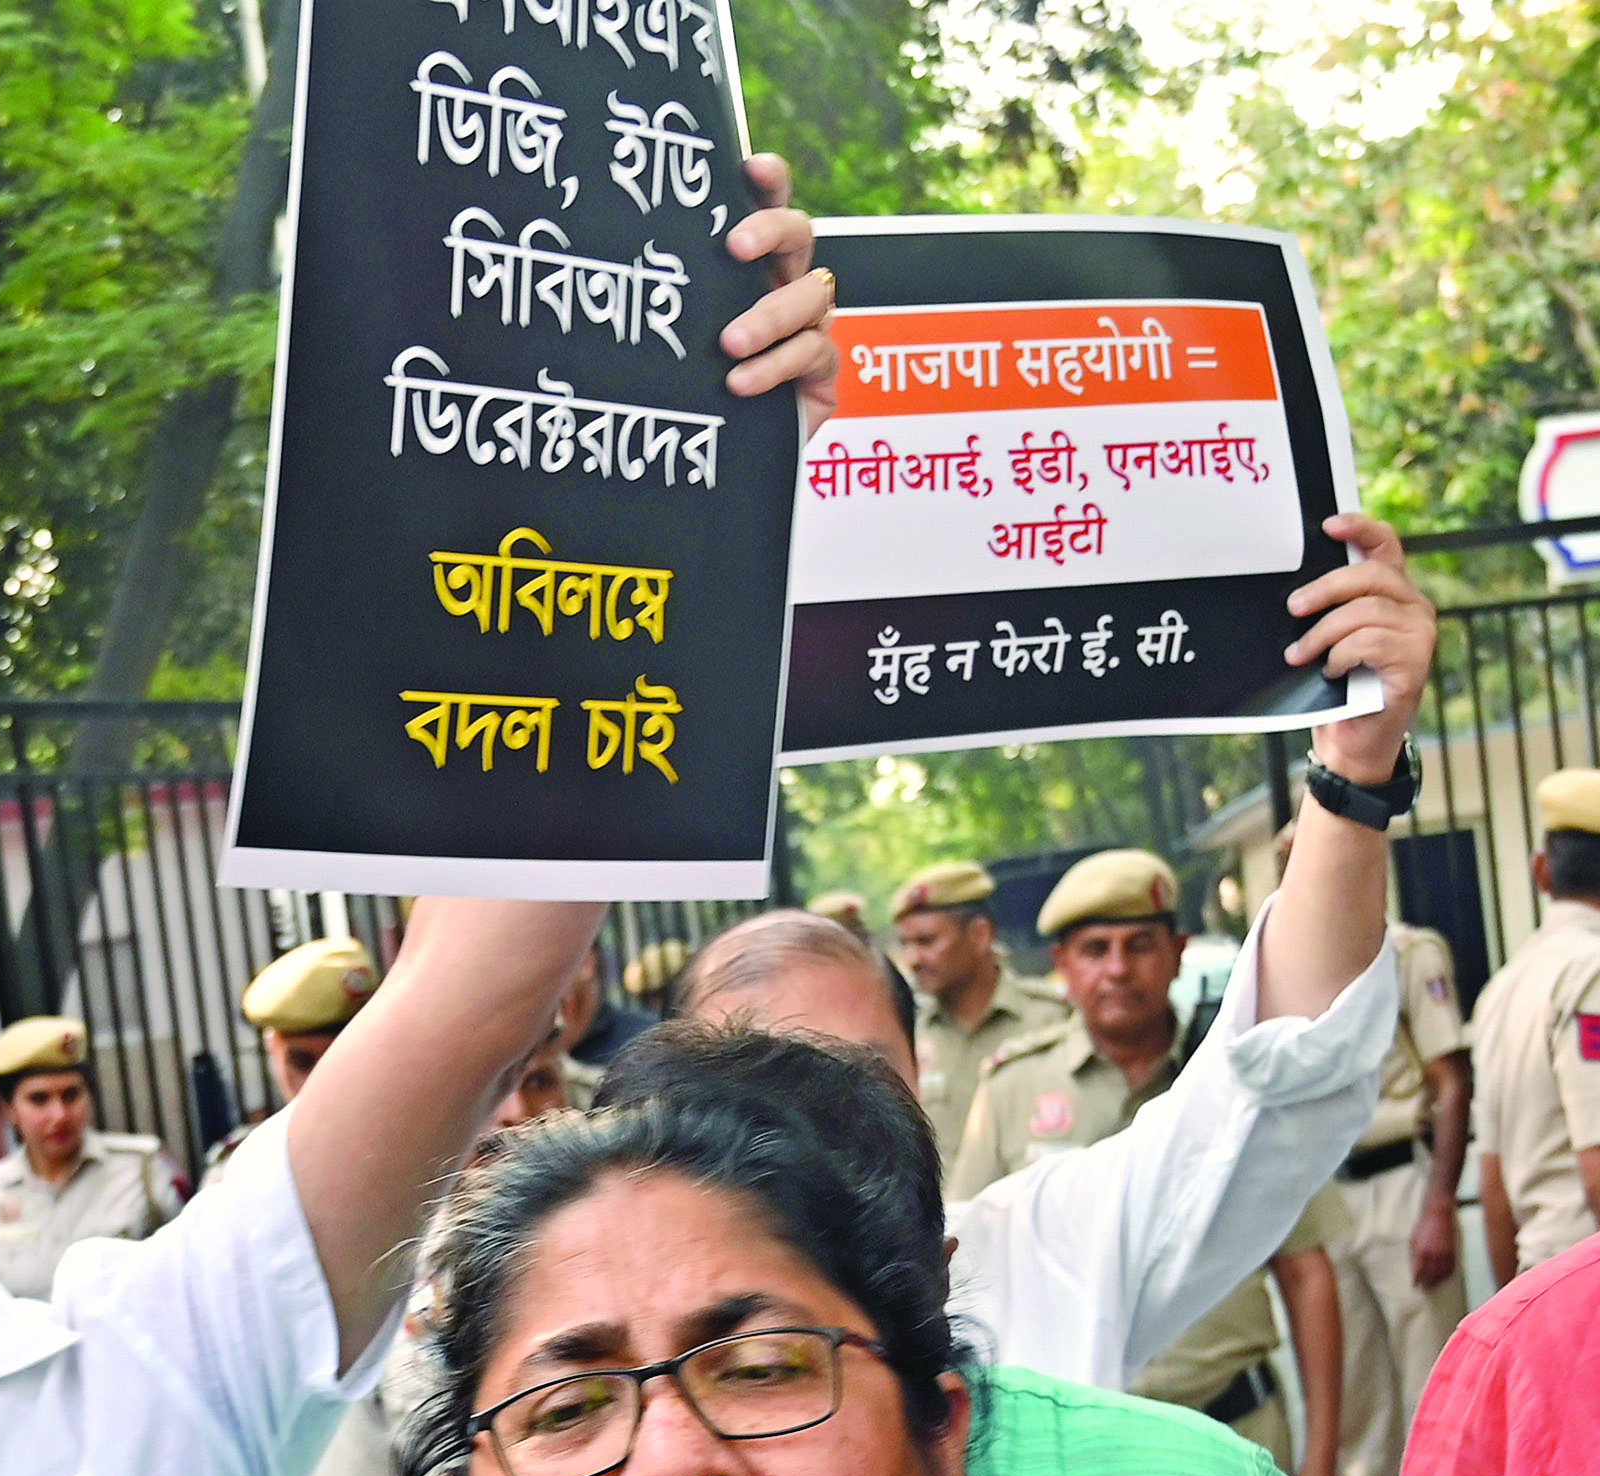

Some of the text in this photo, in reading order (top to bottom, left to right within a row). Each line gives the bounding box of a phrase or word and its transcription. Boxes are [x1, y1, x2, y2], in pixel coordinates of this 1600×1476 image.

[410, 51, 727, 236] ডিজি, ইডি,
[443, 202, 690, 359] সিবিআই
[851, 341, 1002, 392] भाजपा
[1013, 316, 1173, 395] सहयोगी
[384, 343, 725, 489] ডিরেক্টরদের
[807, 422, 1269, 499] सीबीआई, ईडी, एनआईए,
[431, 528, 674, 642] অবিলম্বে
[988, 503, 1108, 565] आईटी
[868, 610, 1194, 704] मुँह न फेरो ई. सी.
[402, 676, 683, 782] বদল চাই
